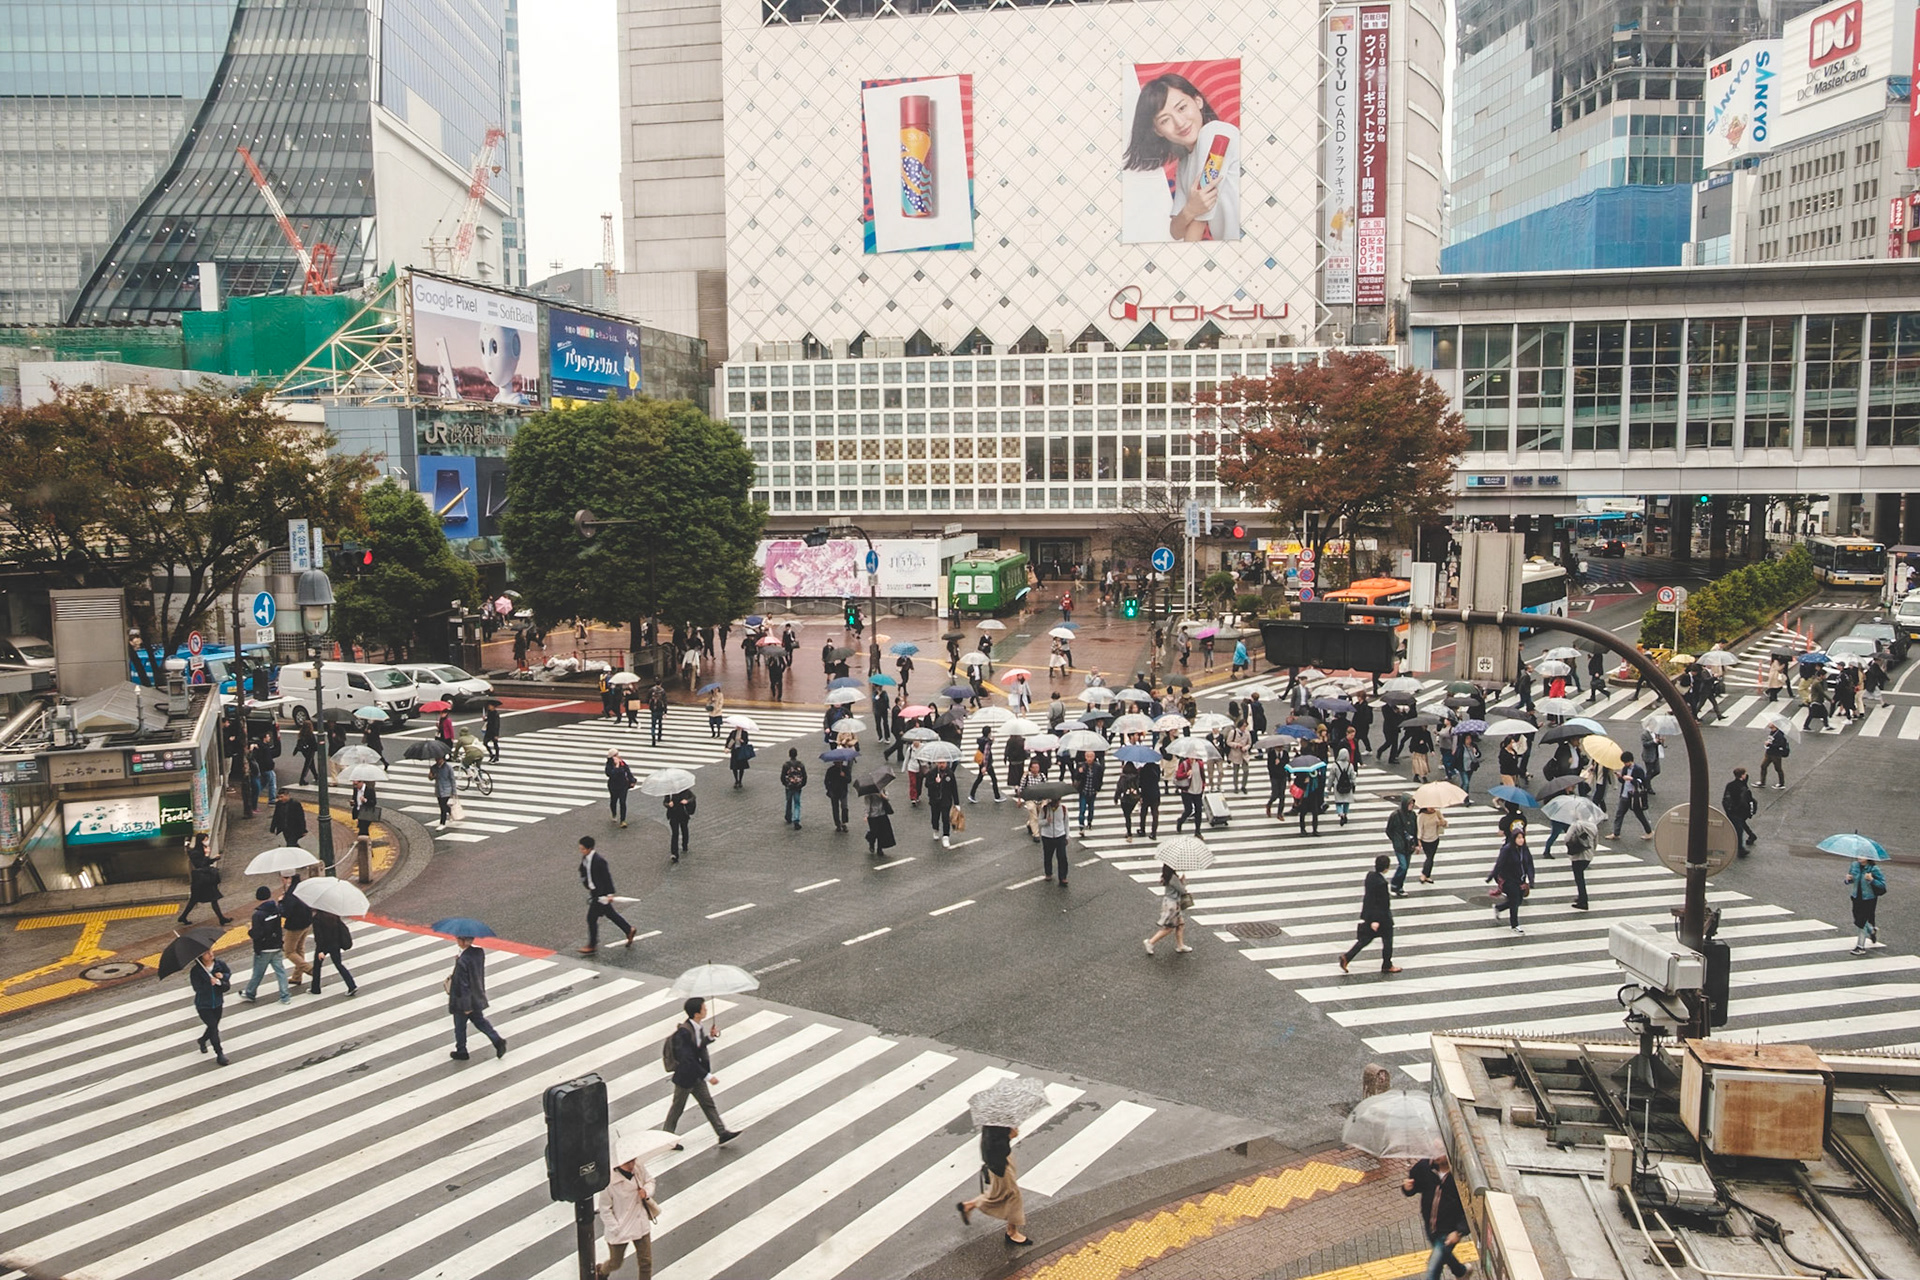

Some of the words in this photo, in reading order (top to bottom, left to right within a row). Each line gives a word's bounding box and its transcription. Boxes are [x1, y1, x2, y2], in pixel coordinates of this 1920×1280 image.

[1813, 8, 1855, 61] DC
[1336, 34, 1347, 91] TOKYU
[1806, 72, 1821, 85] DC
[1824, 60, 1846, 77] VISA
[1707, 59, 1750, 135] SANKYO
[1753, 51, 1777, 142] SANKYO
[1797, 88, 1813, 102] DC
[1813, 65, 1868, 96] MasterCard
[1335, 95, 1346, 142] CARD
[415, 284, 454, 313] Google
[456, 294, 478, 313] Pixel
[1139, 303, 1288, 322] TOKYU
[500, 303, 535, 325] SoftBank
[564, 348, 621, 376] パリのアメリカ人
[521, 375, 538, 392] 11.1
[425, 421, 447, 444] JR
[451, 423, 486, 445] 渋谷駅
[297, 524, 307, 567] 渋谷駅前
[110, 820, 156, 833] しぶちか
